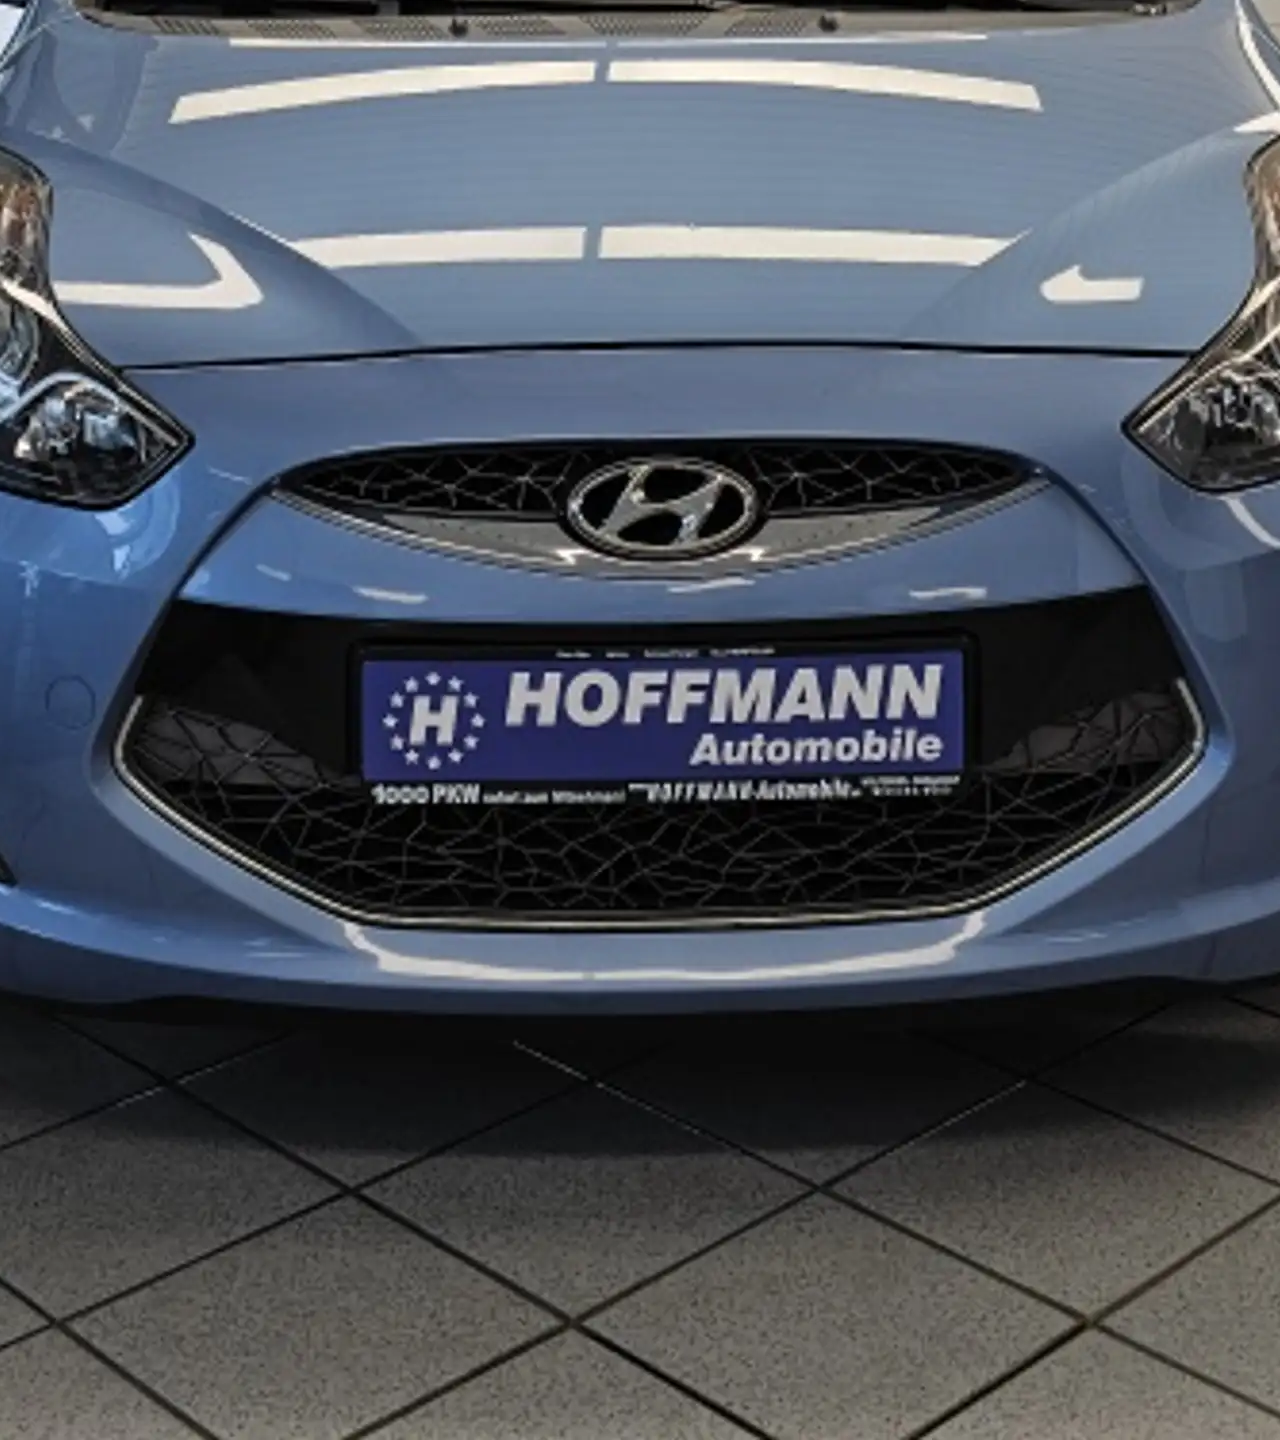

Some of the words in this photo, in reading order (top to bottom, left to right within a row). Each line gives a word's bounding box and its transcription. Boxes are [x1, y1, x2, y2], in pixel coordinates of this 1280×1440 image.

[504, 663, 944, 728] HOFFMANN
[408, 694, 459, 746] H
[688, 727, 944, 766] Automobile
[371, 784, 430, 805] 1000
[432, 783, 481, 805] PKW
